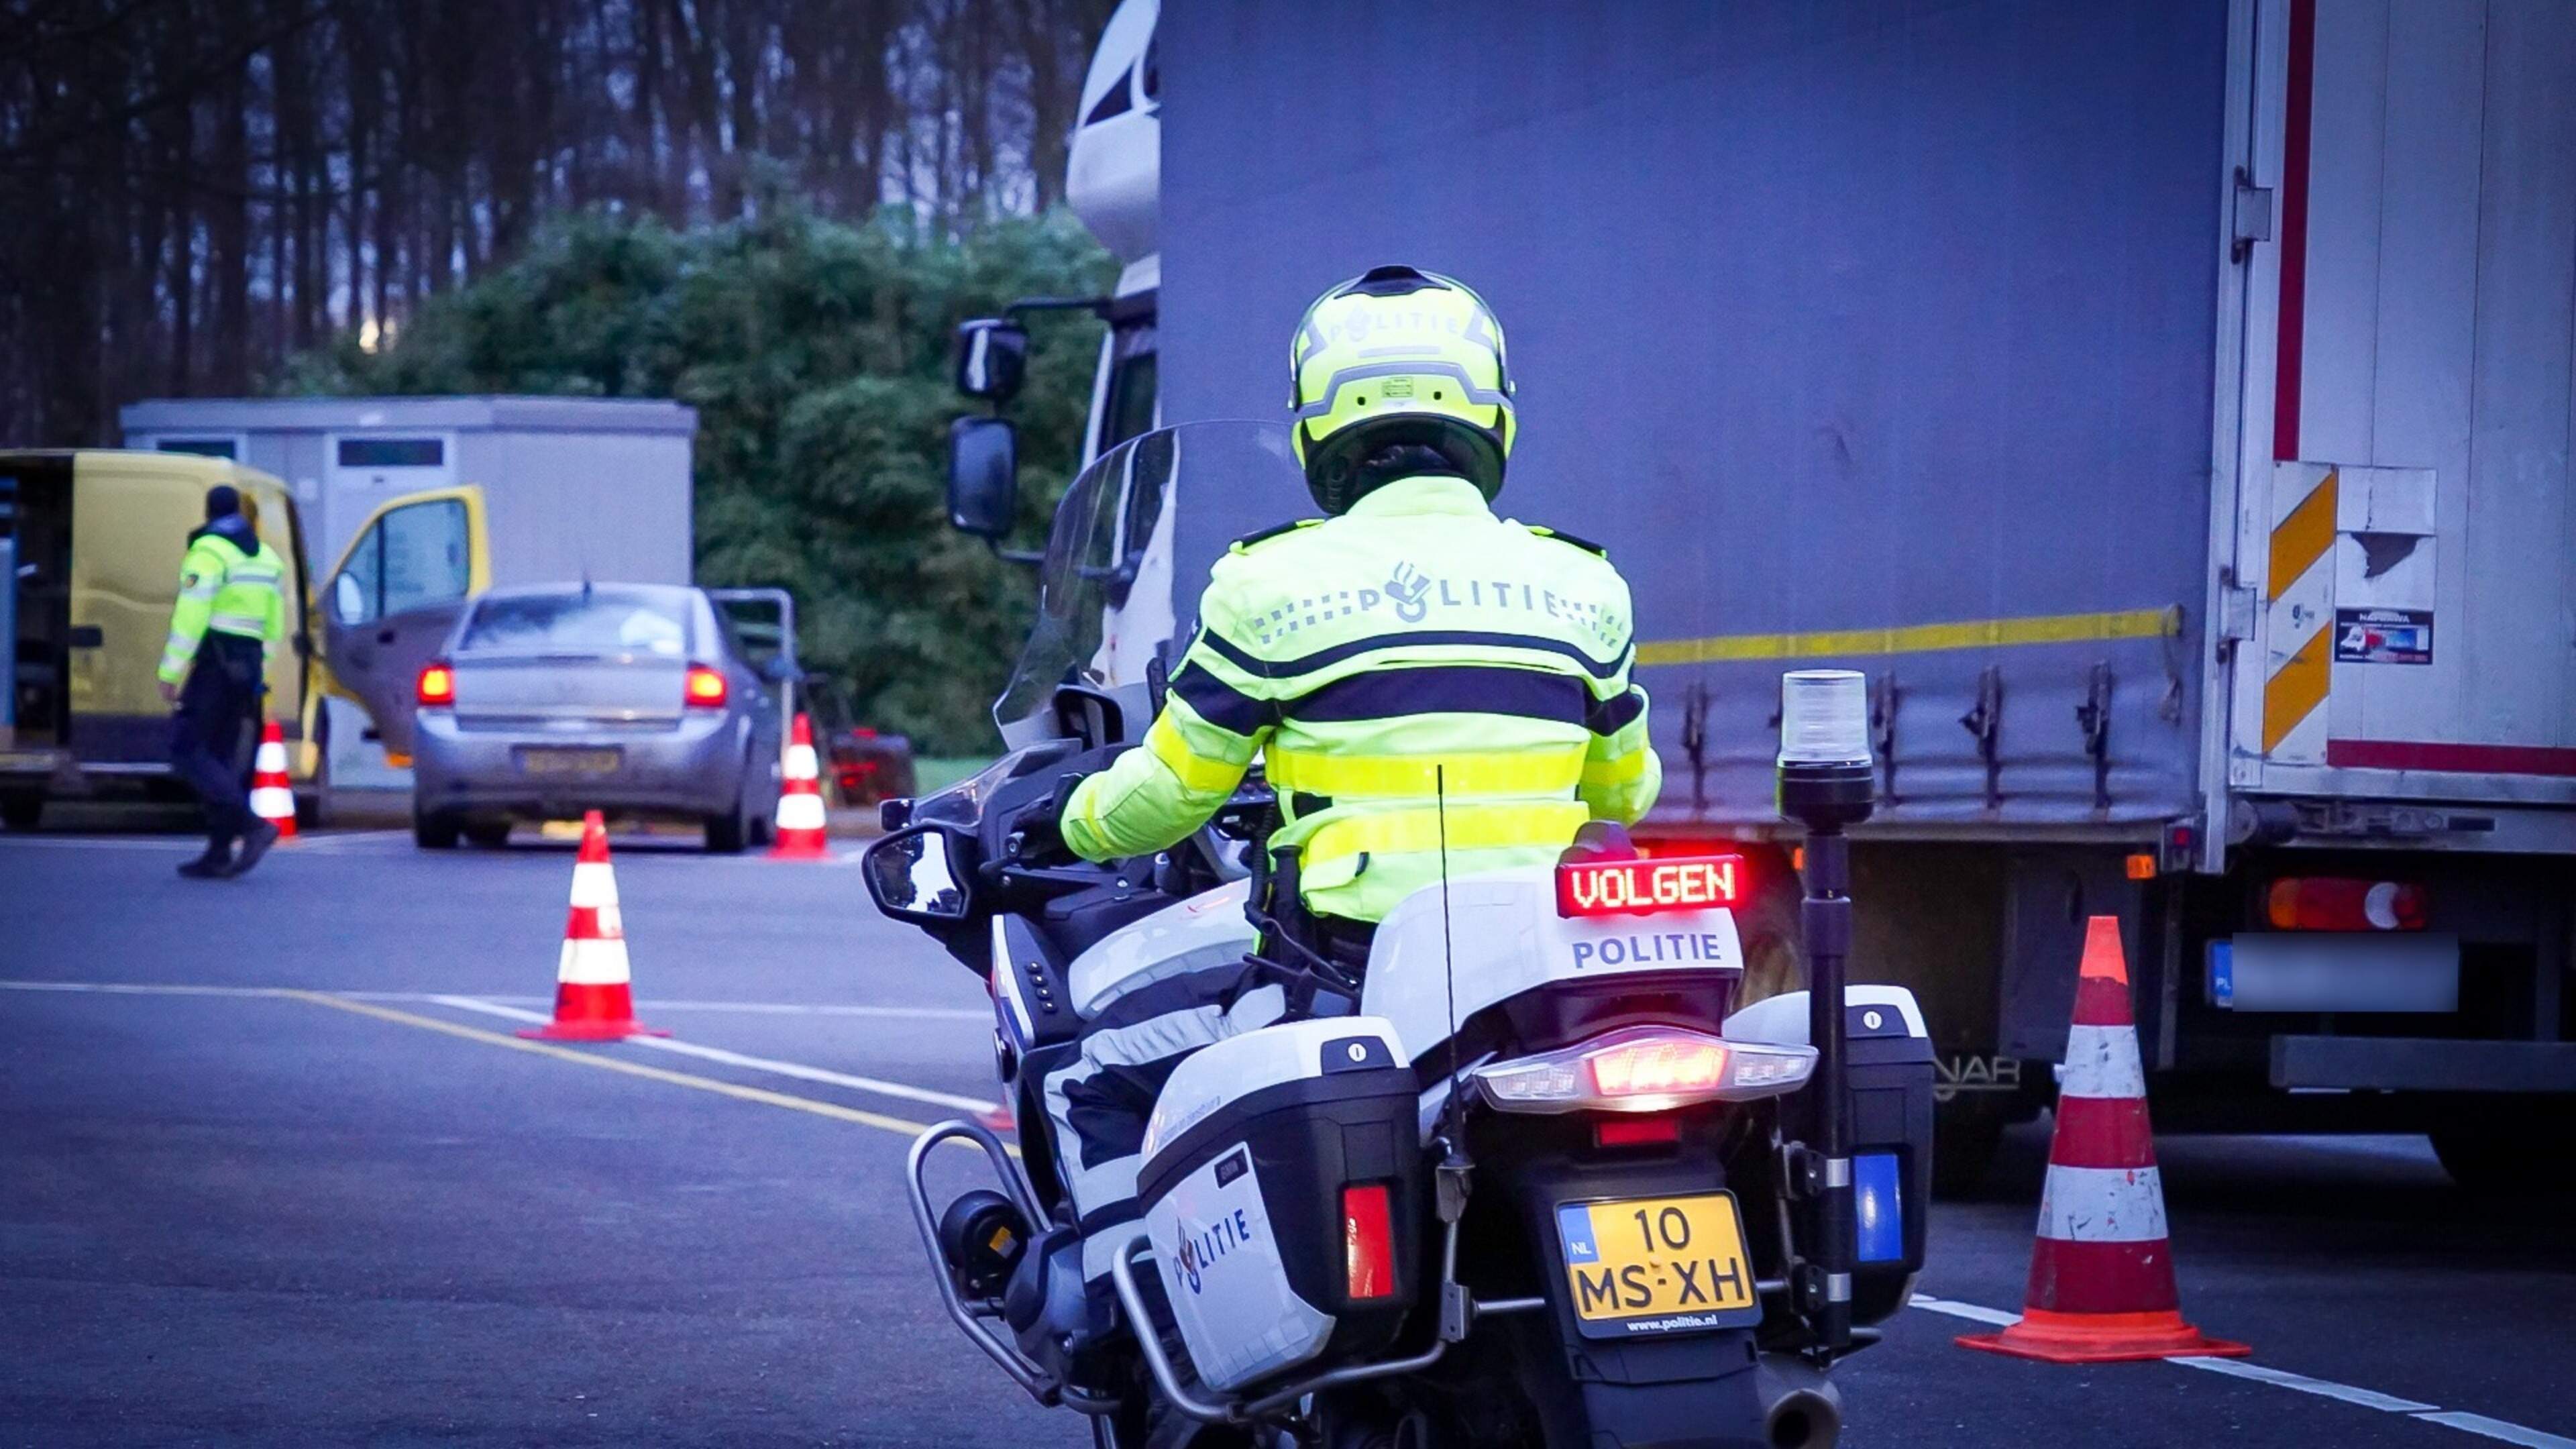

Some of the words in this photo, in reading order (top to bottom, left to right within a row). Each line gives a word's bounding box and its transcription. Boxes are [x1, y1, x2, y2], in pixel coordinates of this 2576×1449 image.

[1358, 578, 1560, 623] POLITIE
[1571, 862, 1736, 909] VOLGEN
[1572, 932, 1721, 969] POLITIE
[1173, 1208, 1250, 1295] POLITIE
[1570, 1241, 1593, 1256] NL
[1633, 1206, 1691, 1253] 10
[1577, 1256, 1747, 1313] MS-XH
[1626, 1313, 1719, 1332] www.politie.nl
